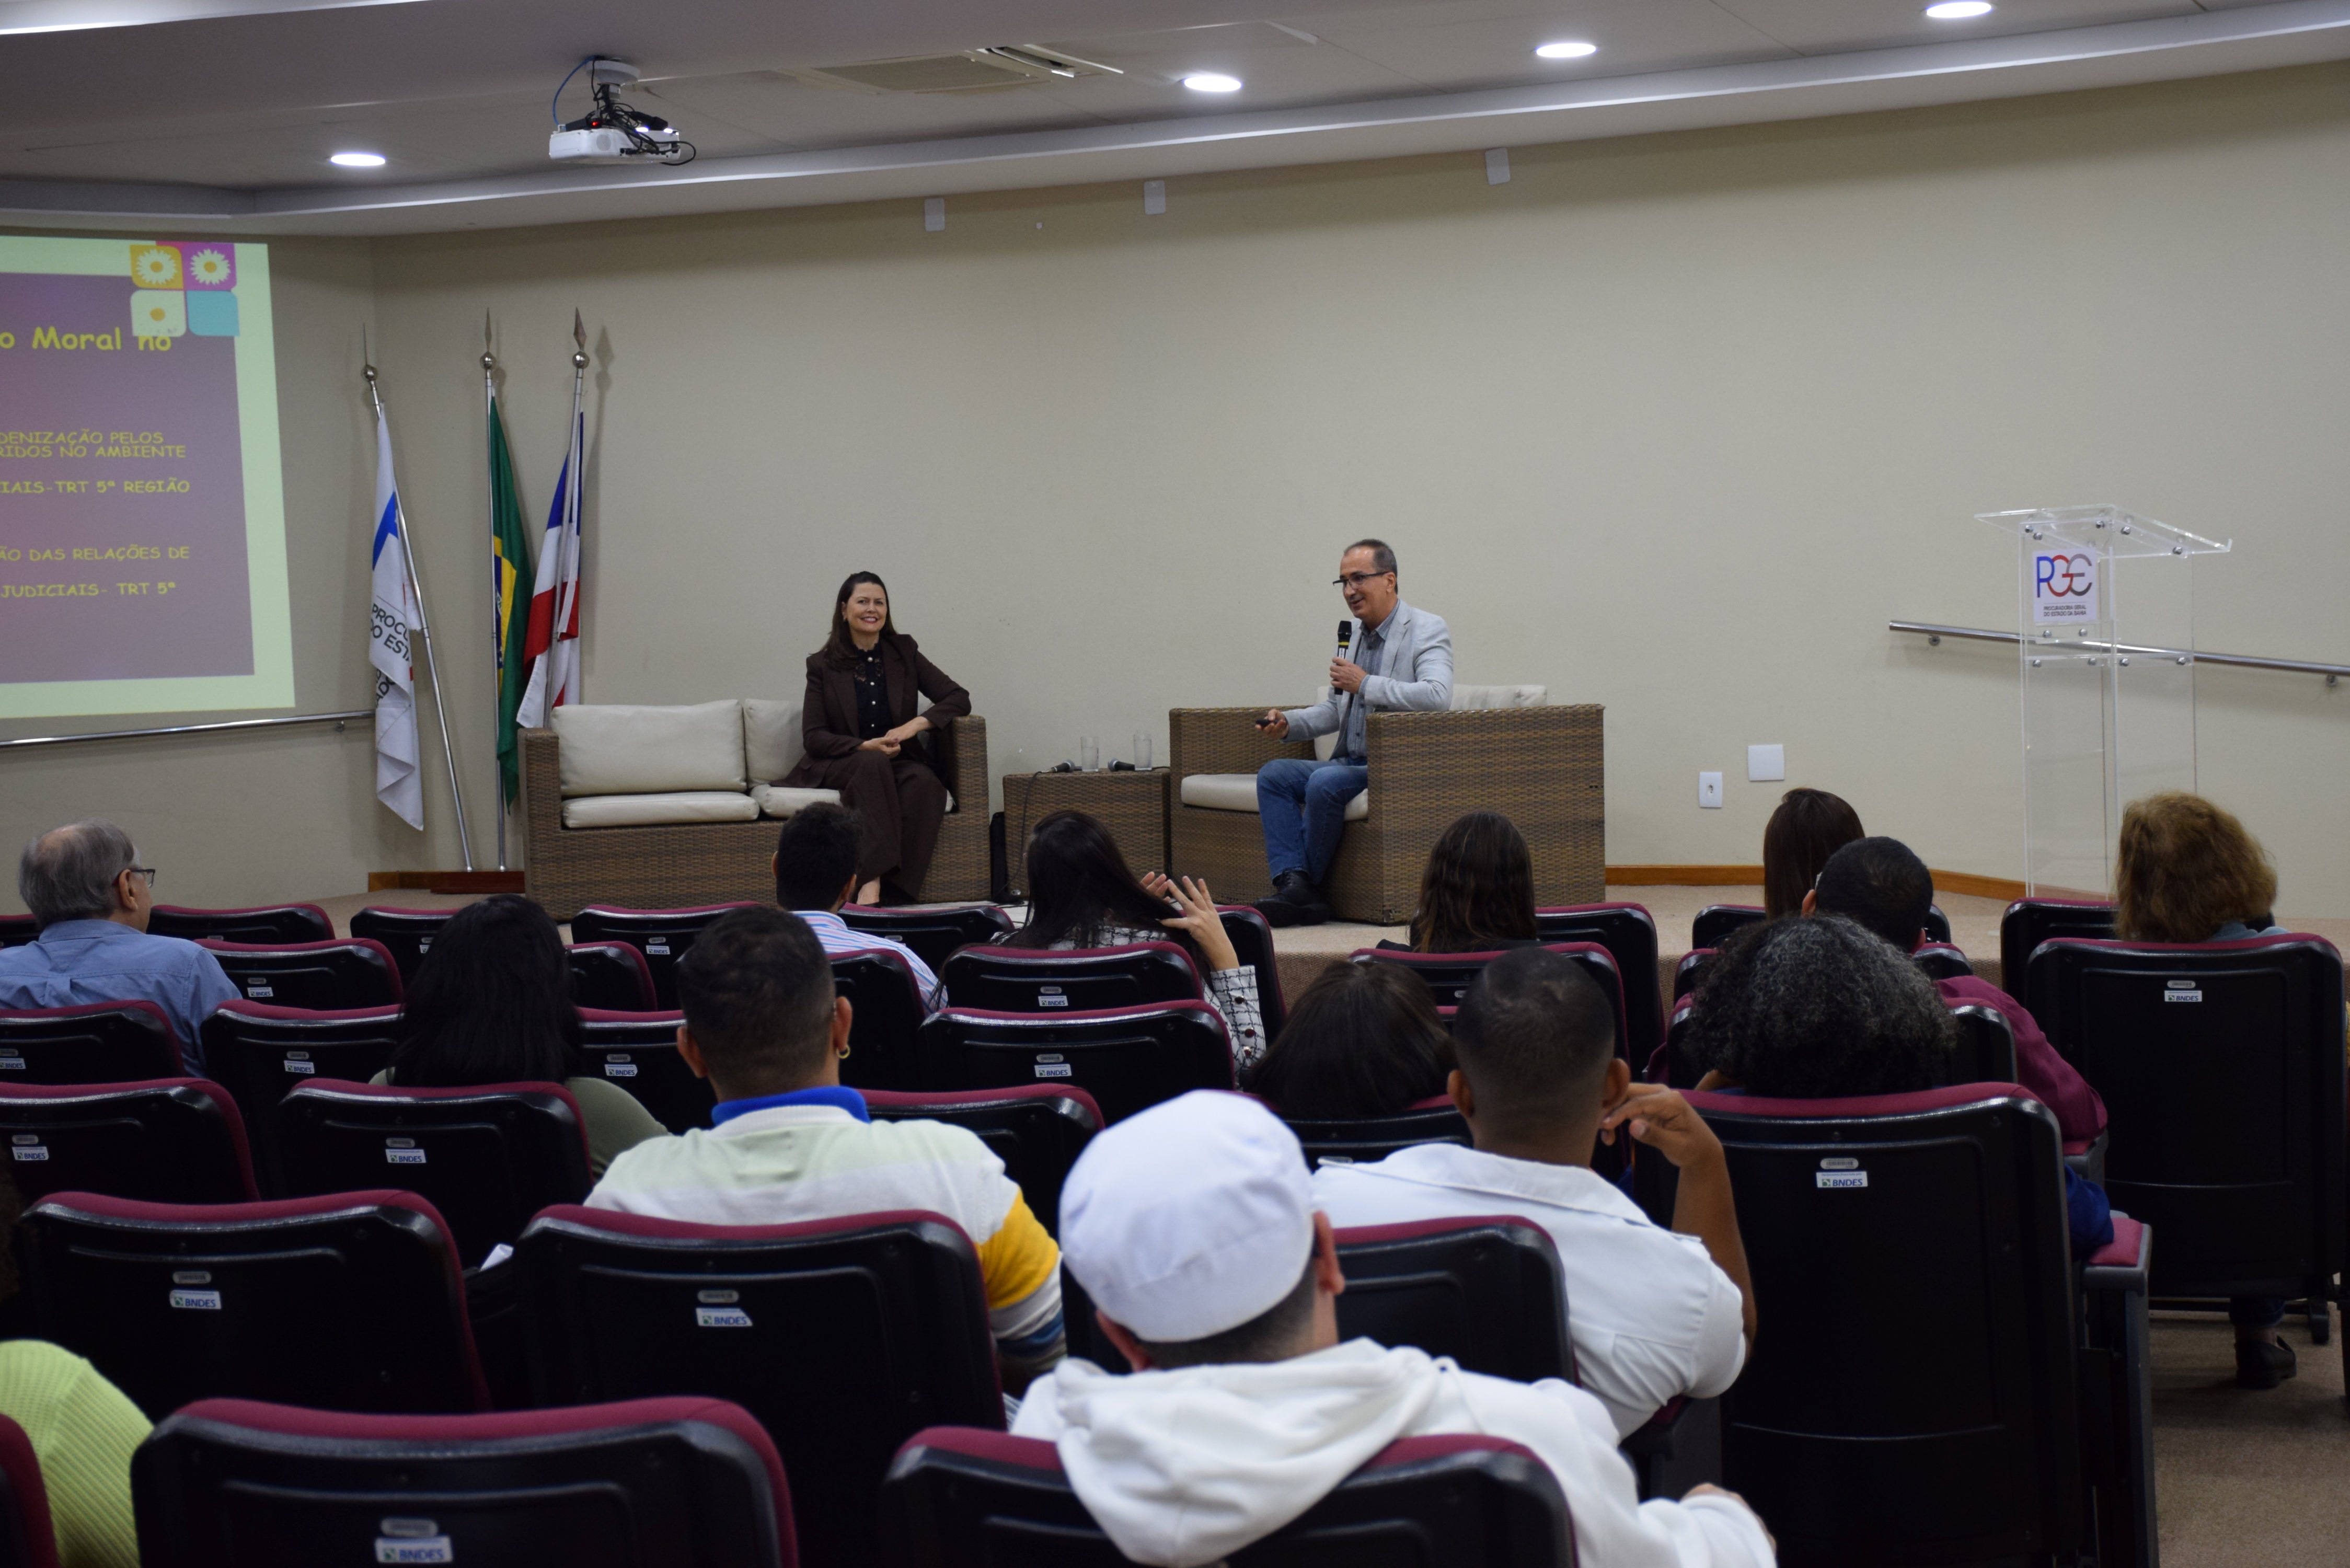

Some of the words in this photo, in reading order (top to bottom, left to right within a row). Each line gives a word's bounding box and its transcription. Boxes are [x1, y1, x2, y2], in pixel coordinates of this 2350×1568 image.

[32, 326, 121, 350] Moral
[138, 335, 172, 351] no
[110, 432, 164, 444] PELOS
[60, 446, 87, 457] NO
[95, 445, 186, 458] AMBIENTE
[124, 477, 190, 493] REGIÃO
[29, 549, 66, 561] DAS
[73, 544, 160, 561] RELAÇÕES
[168, 546, 189, 559] DE
[2037, 554, 2092, 598] PGE
[117, 583, 150, 595] TRT
[1833, 1179, 1863, 1187] BNDES
[185, 1299, 215, 1308] BNDES
[714, 1317, 746, 1326] BNDES
